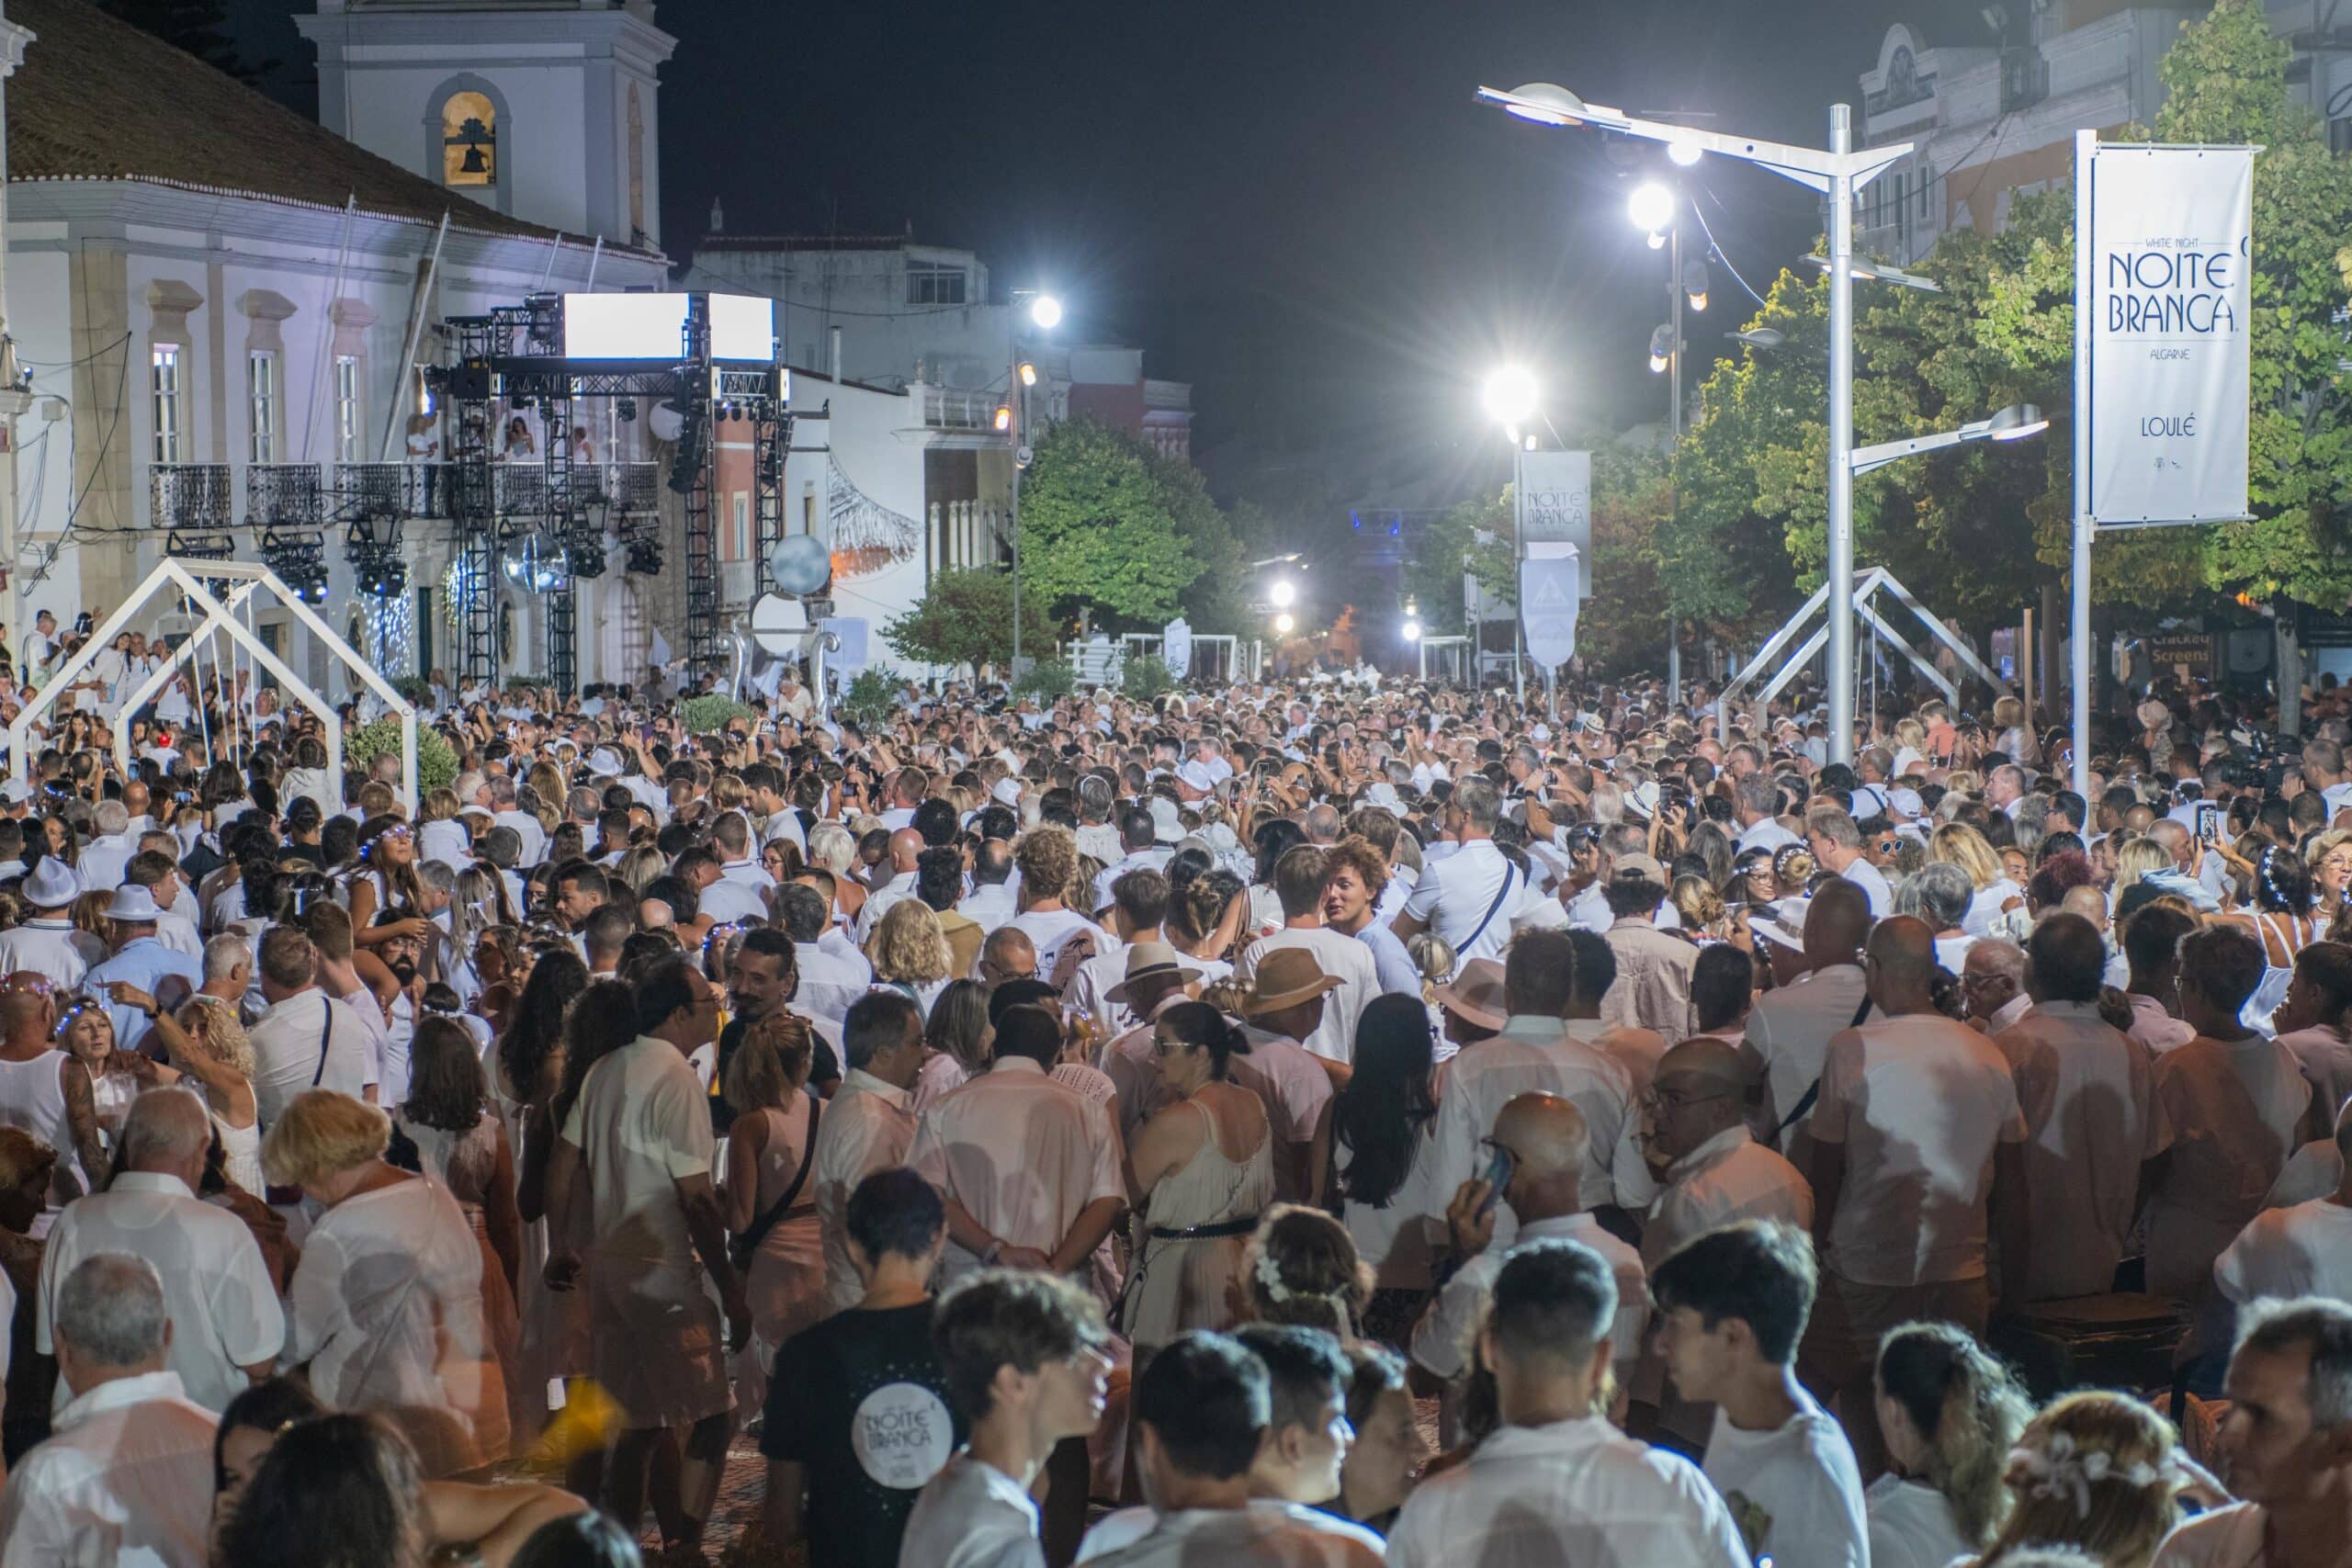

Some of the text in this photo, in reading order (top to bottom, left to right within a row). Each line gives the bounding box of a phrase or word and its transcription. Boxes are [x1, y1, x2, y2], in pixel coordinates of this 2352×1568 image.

[2145, 238, 2199, 249] WHITE NIGHT
[2109, 252, 2234, 288] NOITE
[2109, 293, 2234, 333] BRANCA
[2150, 348, 2190, 360] ALGARVE
[2142, 412, 2197, 436] LOULÉ
[1528, 491, 1582, 507] NOITE
[1528, 508, 1583, 524] BRANCA
[2153, 649, 2210, 662] Screens
[865, 1409, 929, 1431] NOITE
[868, 1428, 932, 1450] BRANCA
